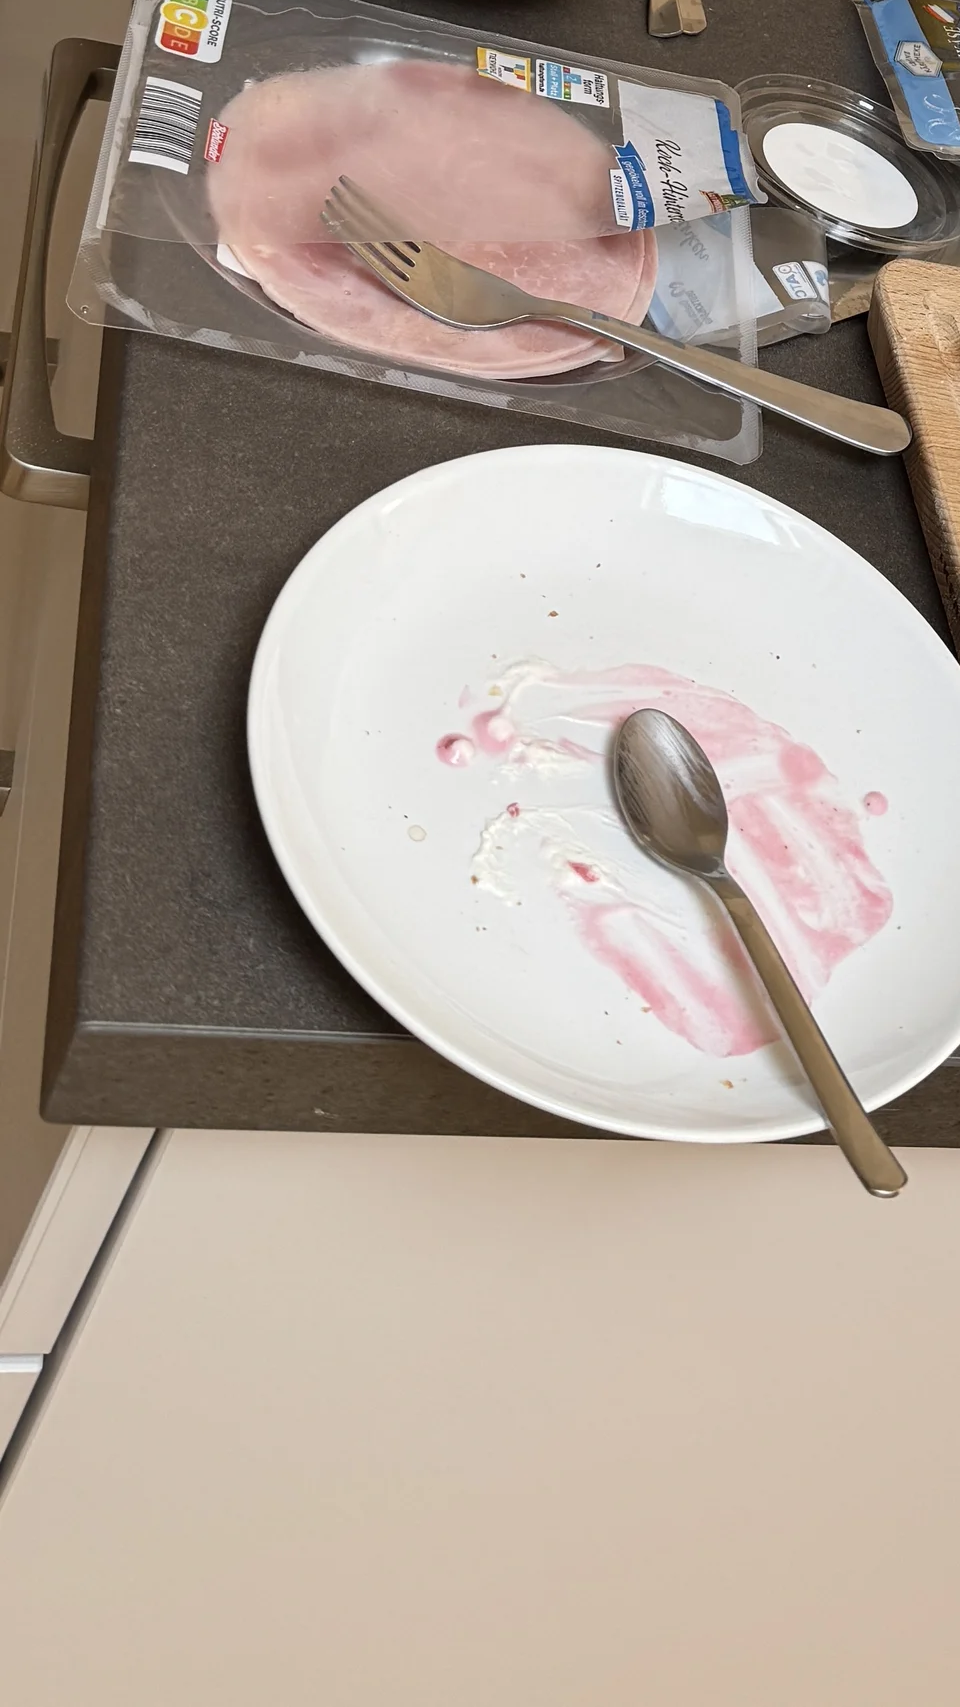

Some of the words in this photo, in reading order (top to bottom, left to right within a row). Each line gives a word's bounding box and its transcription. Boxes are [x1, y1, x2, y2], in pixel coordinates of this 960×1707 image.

[175, 9, 198, 25] C
[582, 79, 593, 95] form
[593, 74, 605, 105] Haltungs-
[613, 175, 629, 222] SPITZENQUALITÄT
